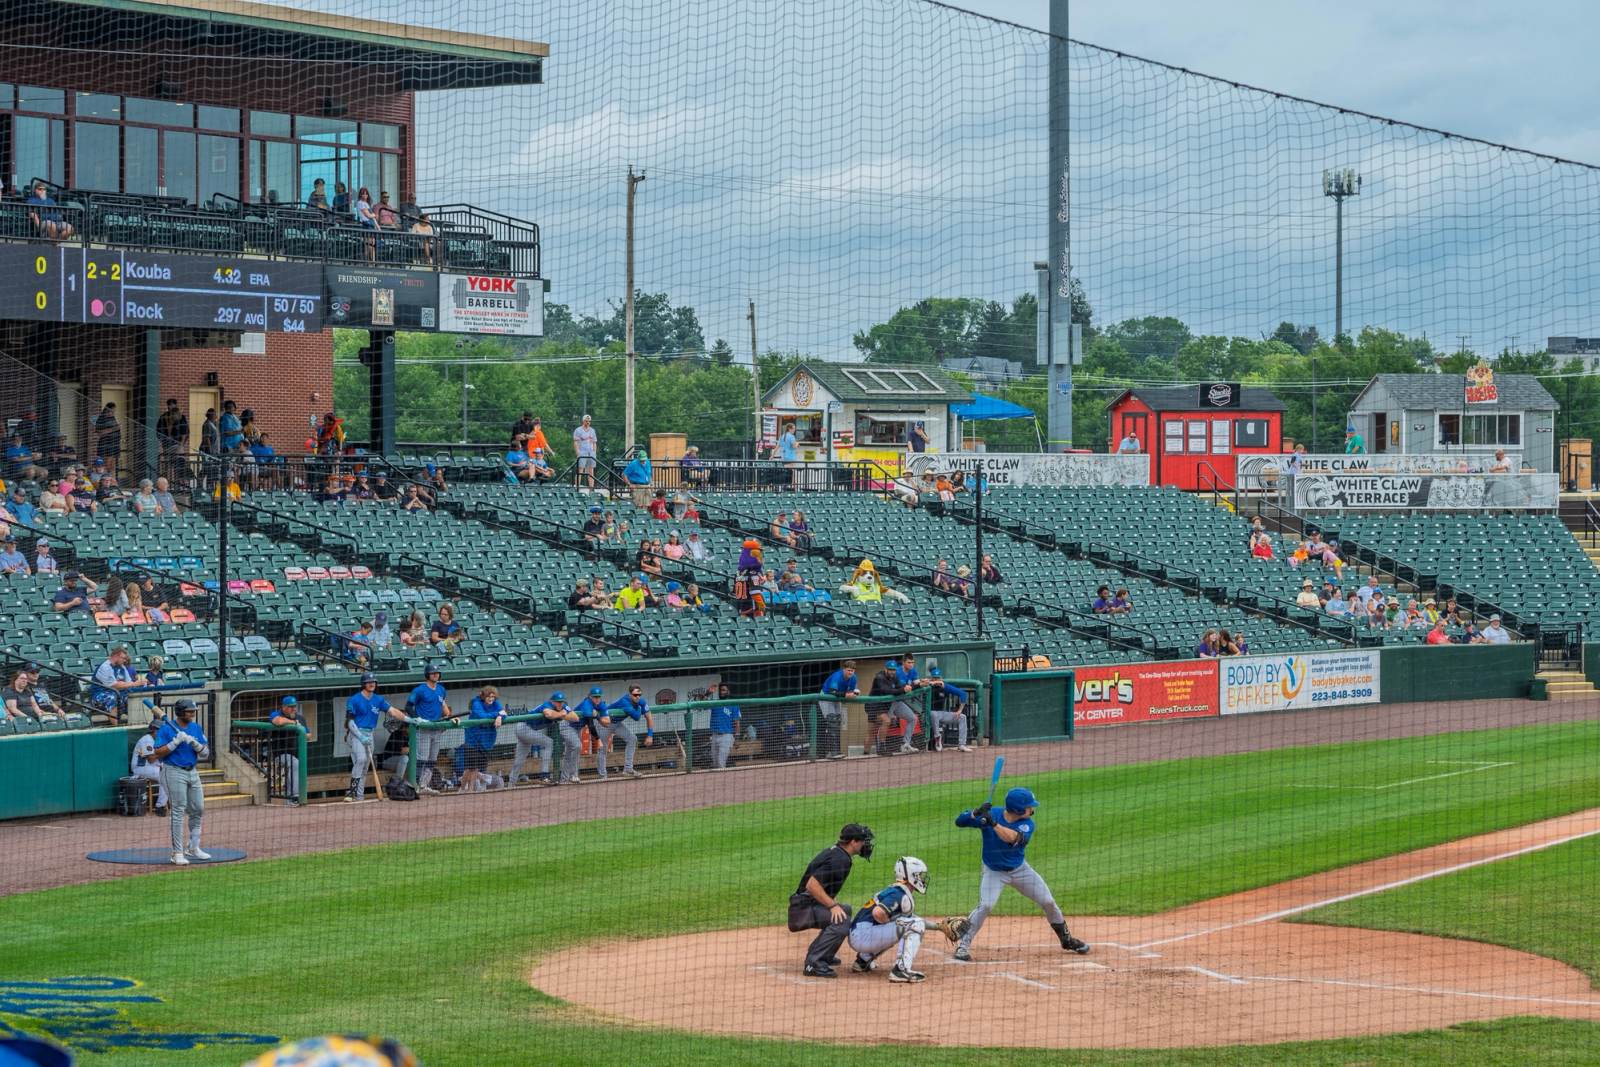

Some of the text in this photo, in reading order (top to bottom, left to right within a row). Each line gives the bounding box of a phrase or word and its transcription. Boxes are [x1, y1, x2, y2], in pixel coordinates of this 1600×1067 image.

[36, 256, 47, 275] 0
[87, 262, 97, 279] 2
[111, 264, 121, 280] 2
[126, 262, 270, 286] Kouba 4.32 ERA
[338, 274, 378, 285] FRIENDSHIP
[68, 273, 76, 291] 1
[467, 276, 516, 293] YORK
[36, 291, 47, 310] 0
[274, 299, 289, 313] 50
[300, 300, 314, 314] 50
[468, 298, 515, 309] BARBELL
[126, 301, 264, 326] Rock .297 AVG
[283, 317, 305, 333] $44
[948, 458, 1020, 470] WHITE CLAW
[1331, 459, 1369, 470] CLAW
[1336, 479, 1380, 491] WHITE
[1381, 479, 1419, 491] CLAW
[1348, 492, 1406, 504] TERRACE
[1227, 663, 1282, 686] BODY BY
[1074, 672, 1134, 704] ver's
[1311, 688, 1372, 701] 223-848-3909
[1086, 708, 1124, 720] CENTER
[1149, 704, 1209, 715] RiversTruck.com
